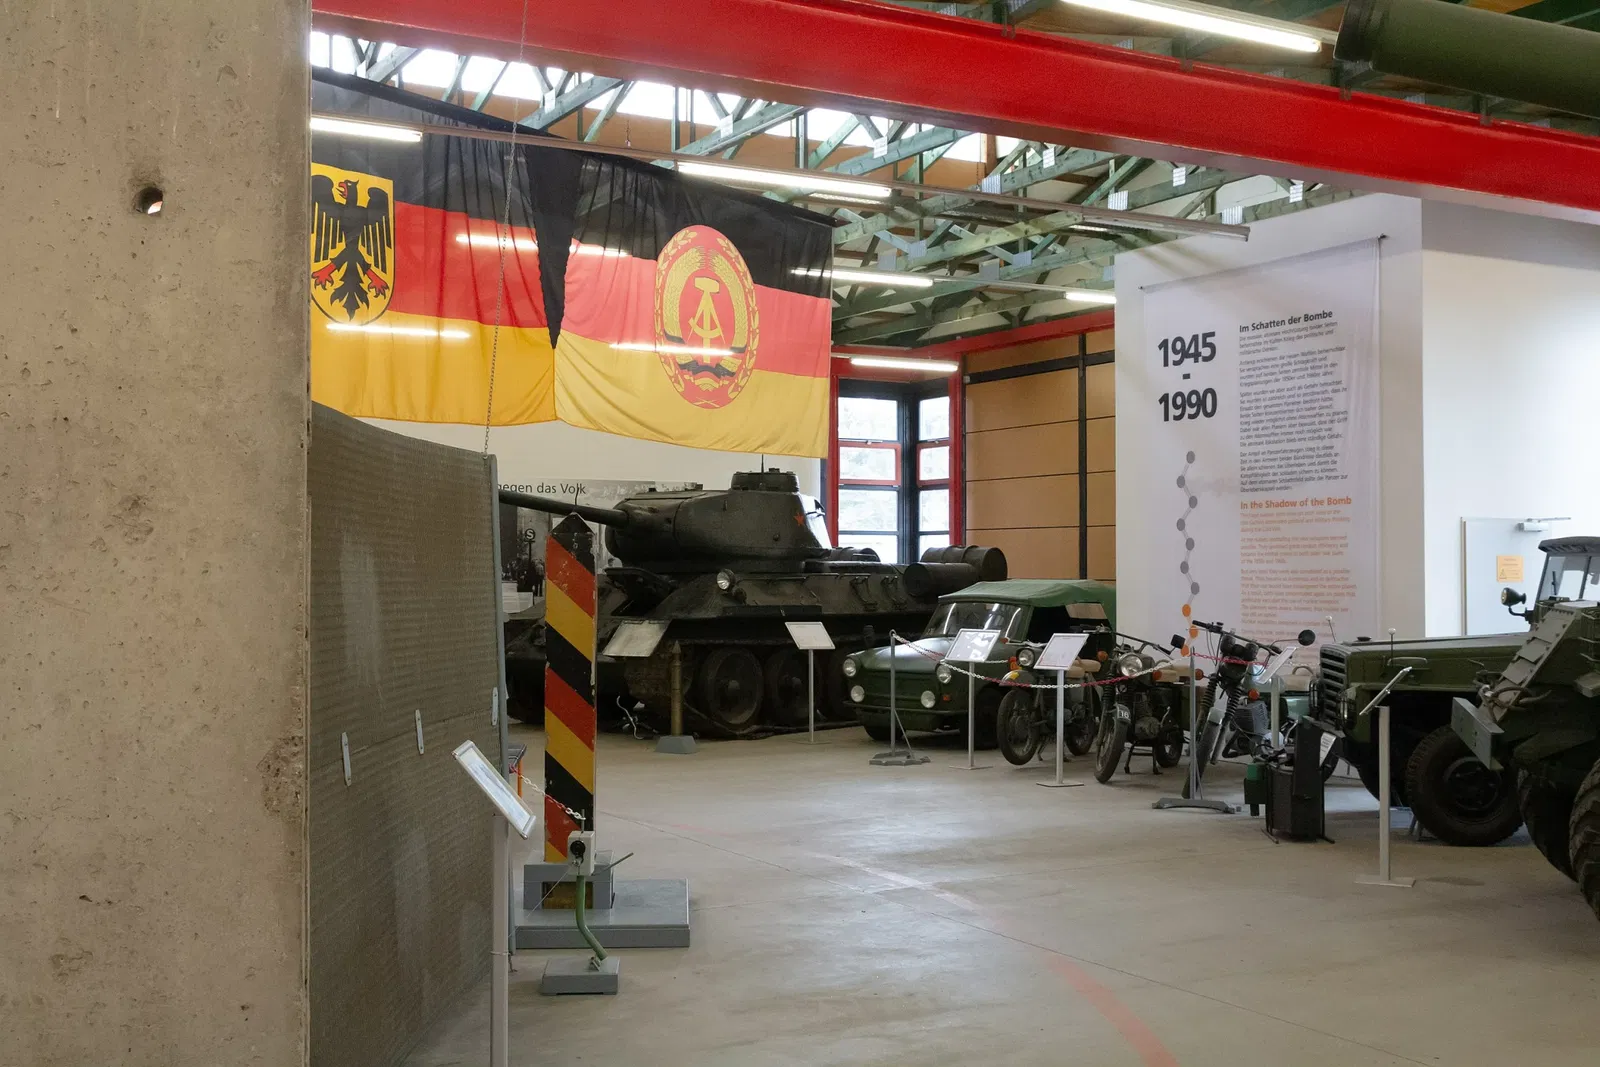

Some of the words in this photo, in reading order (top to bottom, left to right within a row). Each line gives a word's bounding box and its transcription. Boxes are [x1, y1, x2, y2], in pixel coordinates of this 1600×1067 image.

[1239, 324, 1250, 333] Im
[1251, 319, 1286, 331] Schatten
[1287, 316, 1302, 325] der
[1303, 310, 1333, 322] Bombe
[1158, 331, 1216, 367] 1945
[1158, 387, 1217, 422] 1990
[537, 482, 556, 494] das
[1250, 500, 1263, 508] the
[1266, 500, 1297, 508] Shadow
[1300, 498, 1309, 507] of
[1311, 498, 1324, 506] the
[1327, 496, 1352, 506] Bomb
